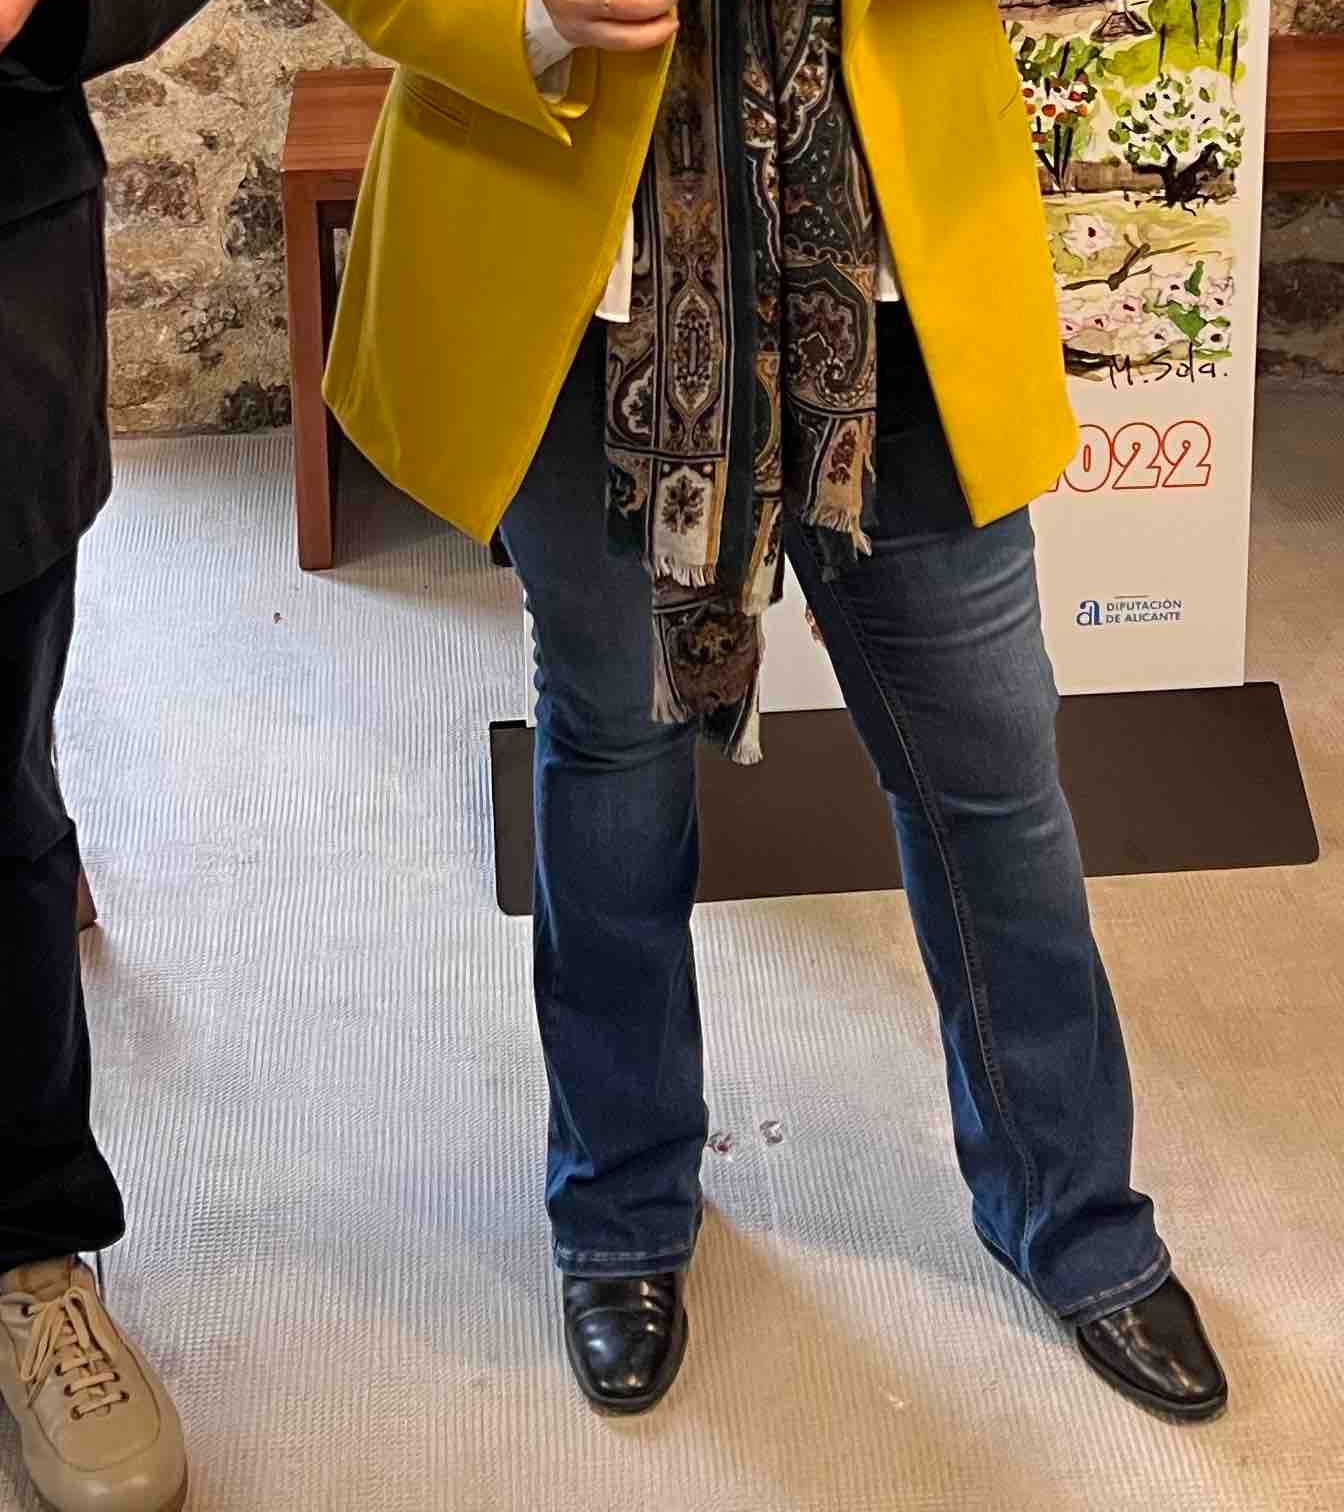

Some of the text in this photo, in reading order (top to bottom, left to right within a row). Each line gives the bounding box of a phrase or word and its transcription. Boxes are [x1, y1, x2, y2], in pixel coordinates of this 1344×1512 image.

[1047, 420, 1213, 493] 022
[1105, 611, 1181, 624] DE ALICANTE
